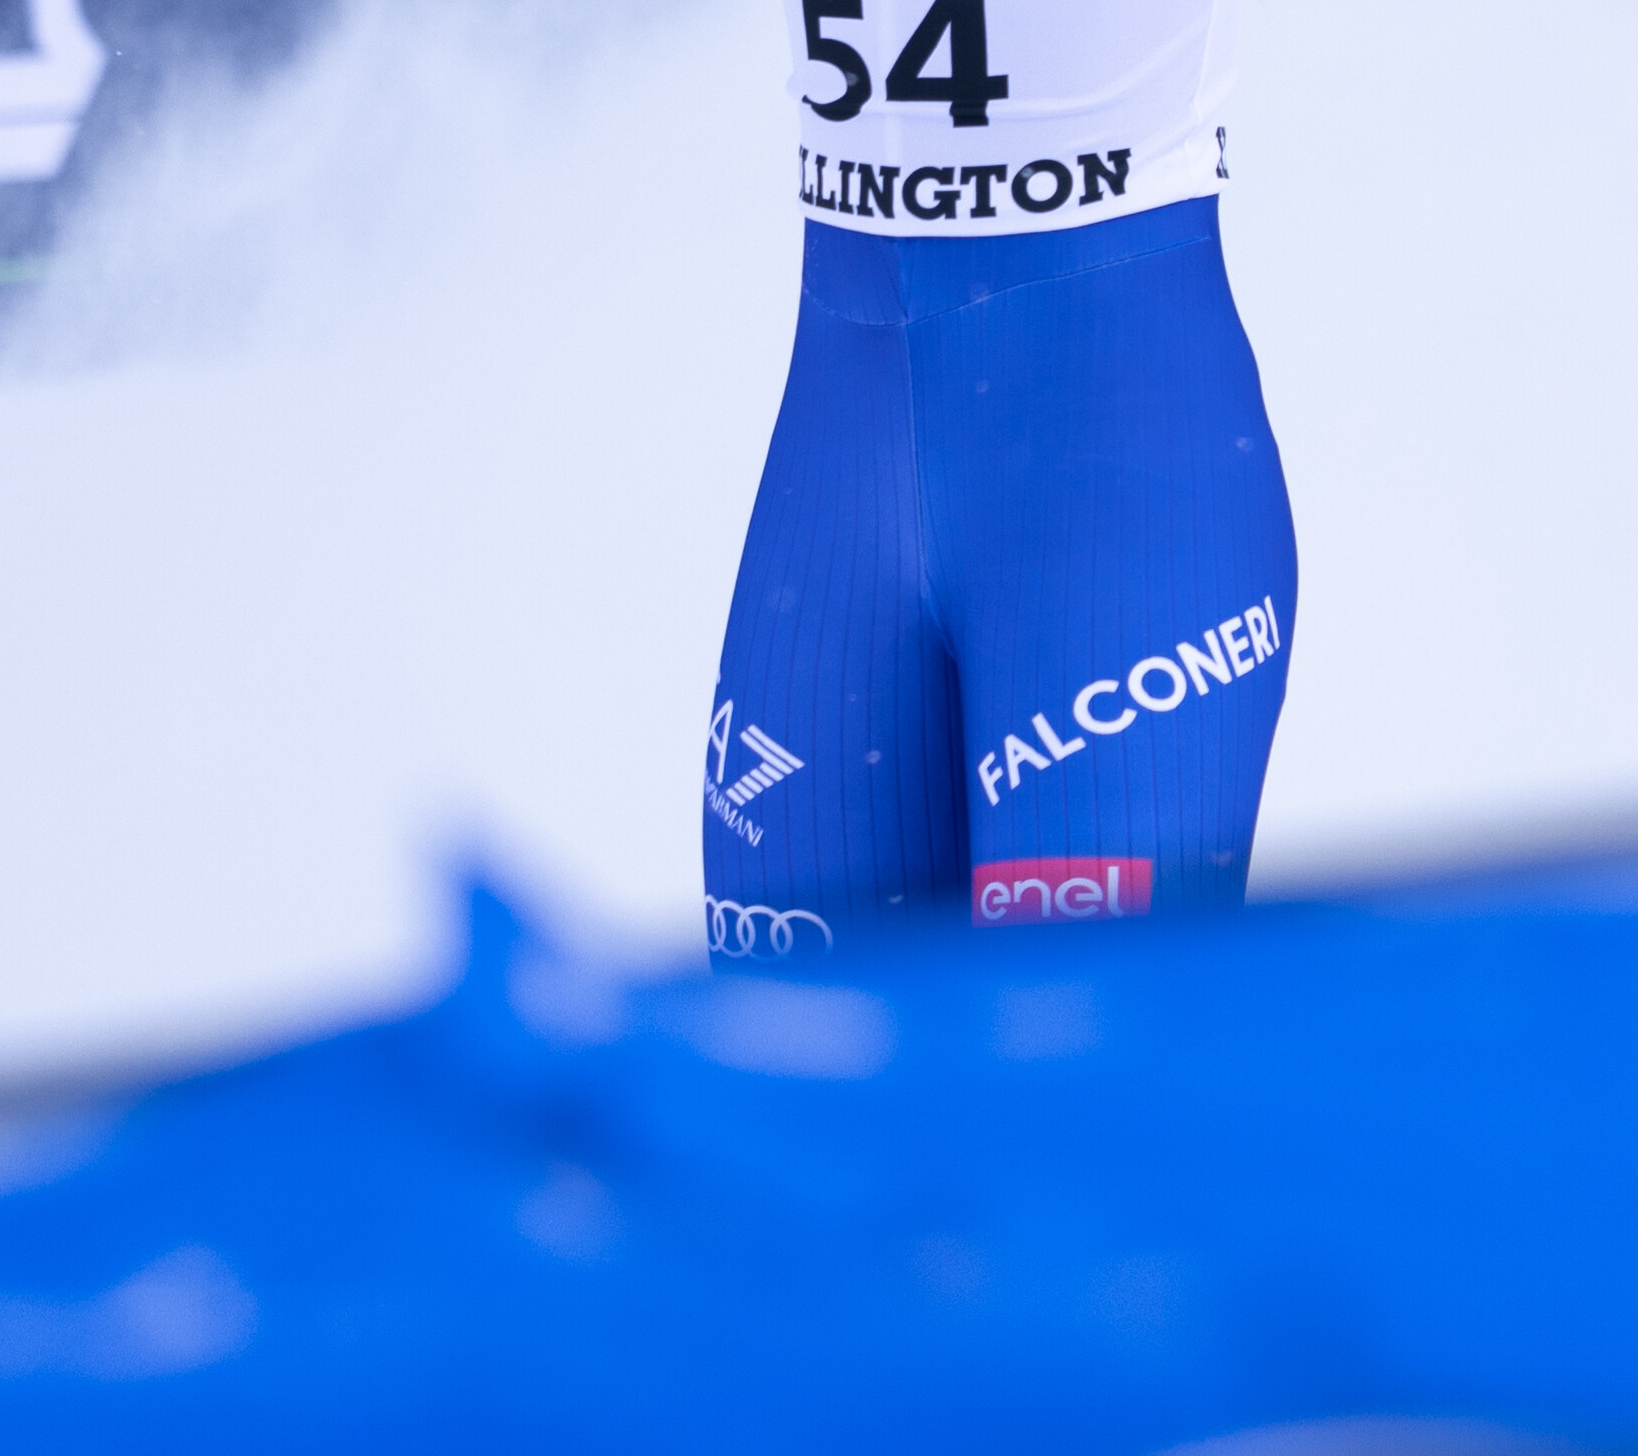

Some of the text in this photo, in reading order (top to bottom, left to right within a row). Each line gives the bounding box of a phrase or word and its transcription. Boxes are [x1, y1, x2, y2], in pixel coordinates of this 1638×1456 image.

[799, 144, 1132, 220] LLINGTON
[976, 595, 1281, 806] FALCONERI
[981, 865, 1125, 920] enel
